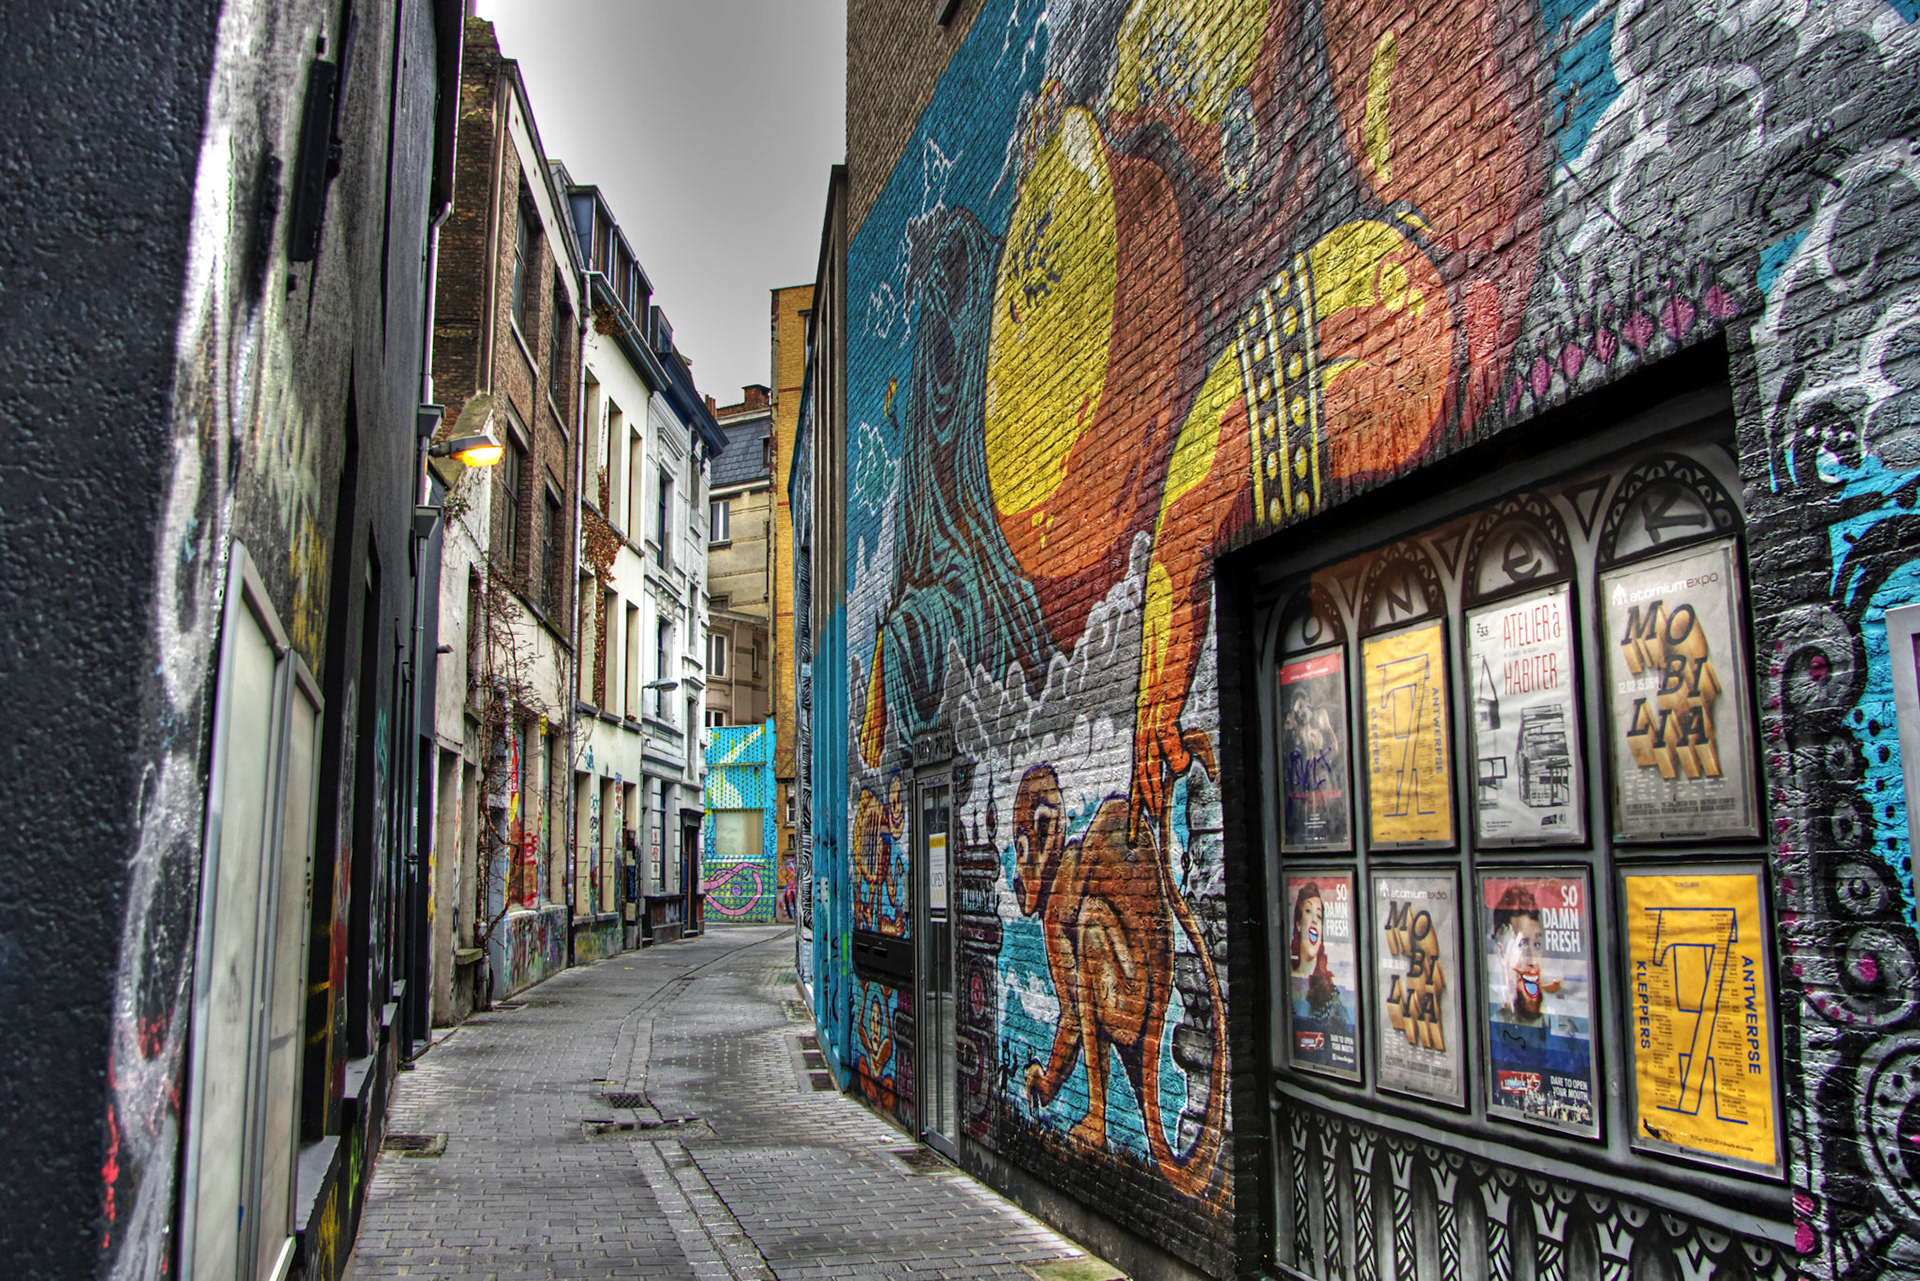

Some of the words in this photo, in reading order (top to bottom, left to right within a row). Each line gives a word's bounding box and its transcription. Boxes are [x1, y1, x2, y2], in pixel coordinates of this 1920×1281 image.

[1503, 604, 1551, 650] ATELIER
[1552, 602, 1561, 638] à
[1503, 653, 1558, 696] HABITER
[1371, 707, 1380, 774] KLEPPERS
[1431, 687, 1443, 774] ANTWERPSE
[1336, 883, 1347, 901] SO
[1560, 885, 1578, 907] SO
[1325, 902, 1348, 919] DAMN
[1542, 908, 1579, 929] DAMN
[1326, 920, 1349, 937] FRESH
[1545, 930, 1581, 953] FRESH
[1636, 961, 1651, 1049] KLEPPERS
[1741, 955, 1761, 1075] ANTWERPSE
[1550, 1075, 1564, 1087] DARE
[1564, 1078, 1573, 1088] TO
[1573, 1079, 1588, 1091] OPEN
[1552, 1086, 1568, 1097] YOUR
[1567, 1089, 1588, 1101] MOUTH
